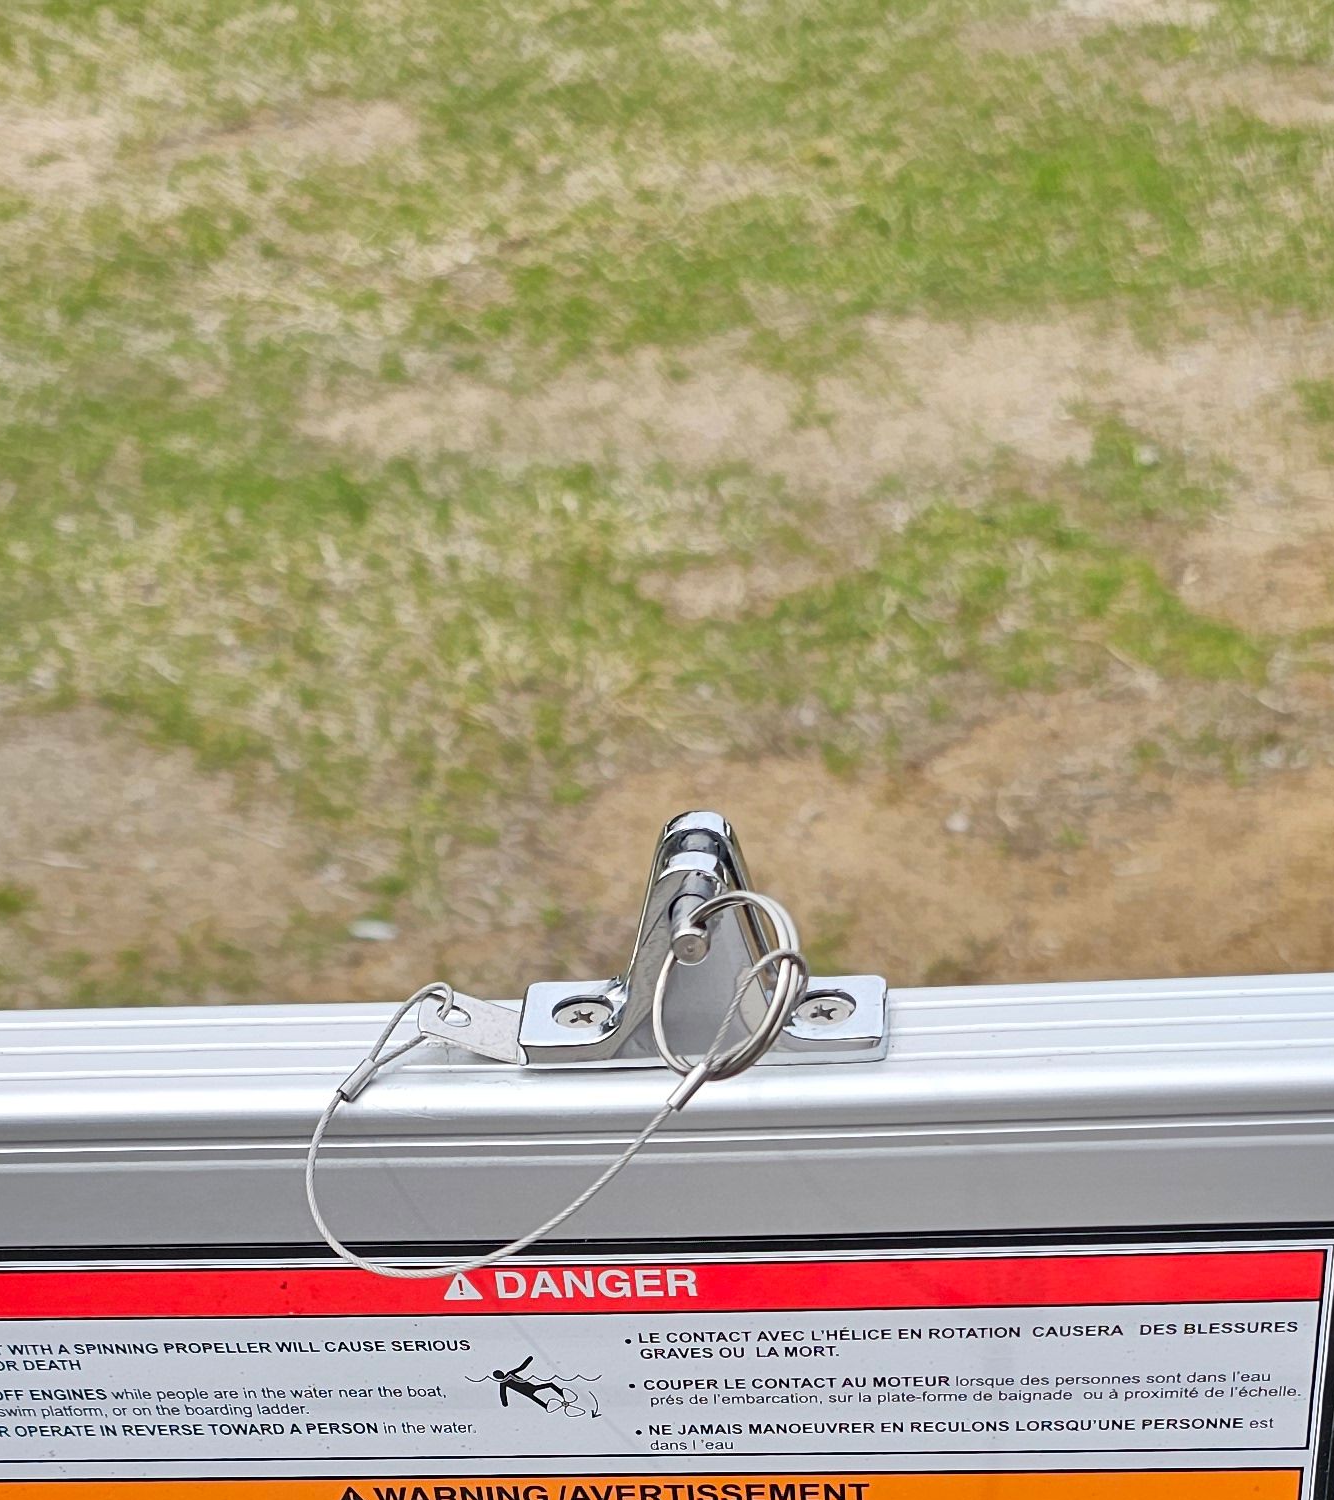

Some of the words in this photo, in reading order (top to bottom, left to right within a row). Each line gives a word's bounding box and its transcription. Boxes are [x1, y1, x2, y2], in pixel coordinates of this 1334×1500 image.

[494, 1268, 698, 1299] DANGER
[637, 1332, 661, 1344] LE
[665, 1331, 752, 1344] CONTACT
[756, 1330, 805, 1342] AVEC
[897, 1328, 922, 1340] EN
[928, 1326, 1021, 1340] ROTATION
[1032, 1324, 1124, 1338] CAUSERA
[1139, 1323, 1178, 1336] DES
[1183, 1321, 1298, 1335] BLESSURES
[6, 1344, 54, 1356] WITH
[57, 1343, 71, 1355] A
[73, 1343, 159, 1355] SPINNING
[162, 1342, 273, 1354] PROPELLER
[274, 1341, 321, 1353] WILL
[321, 1340, 387, 1353] CAUSE
[390, 1339, 471, 1352] SERIOUS
[22, 1359, 82, 1371] DEATH
[28, 1388, 108, 1401] ENGINES
[110, 1388, 153, 1400] while
[155, 1387, 209, 1403] people
[213, 1390, 239, 1399] are
[242, 1387, 259, 1401] in
[260, 1386, 288, 1399] the
[289, 1387, 334, 1398] water
[338, 1388, 374, 1398] near
[377, 1385, 403, 1398] the
[406, 1385, 447, 1399] boat,
